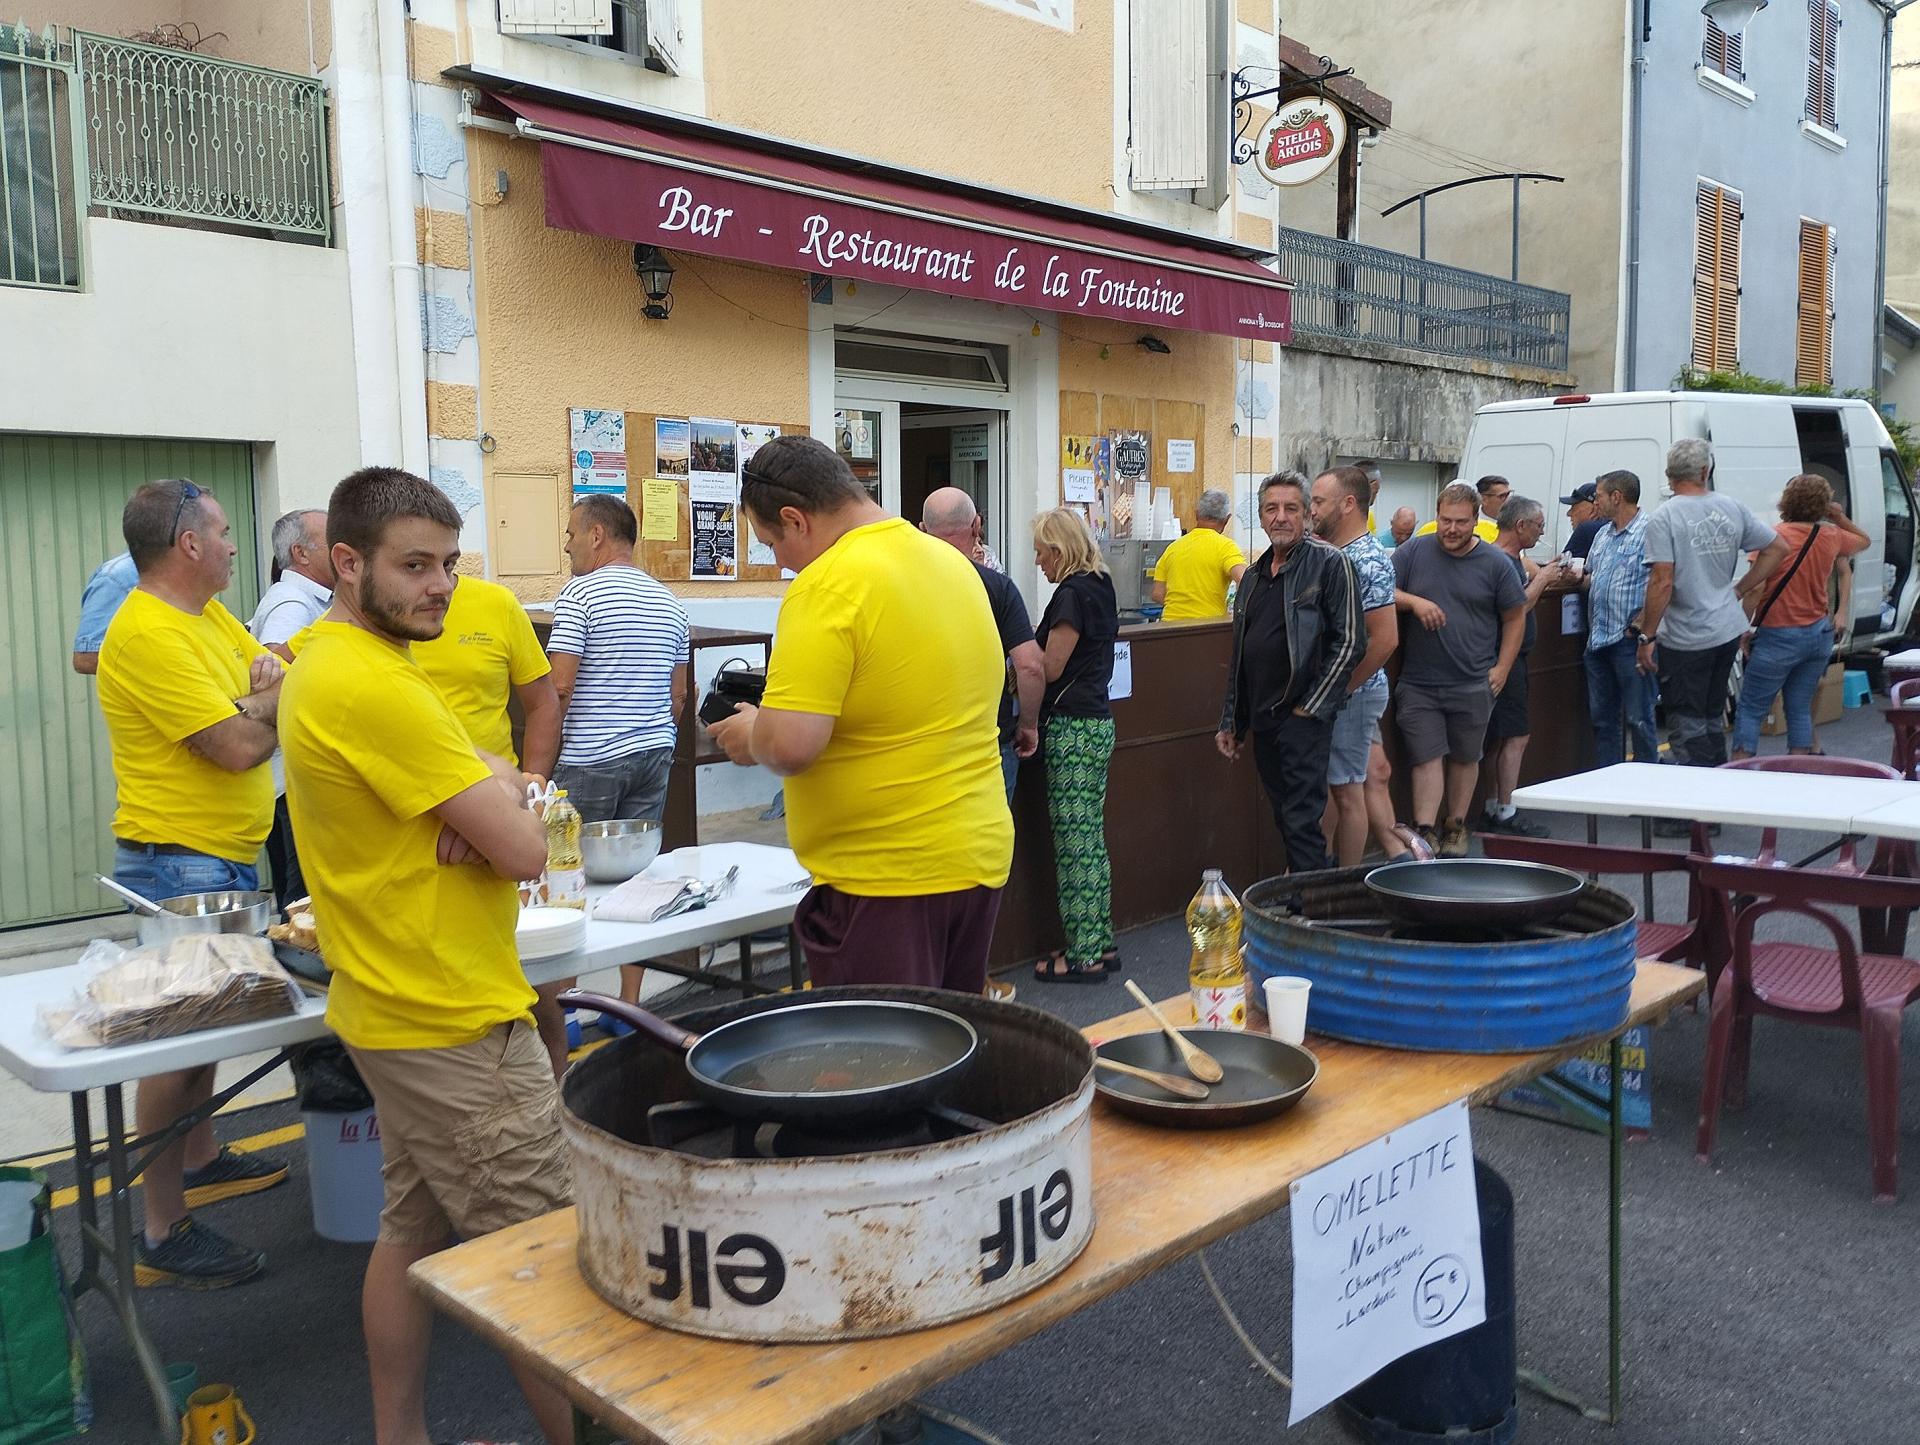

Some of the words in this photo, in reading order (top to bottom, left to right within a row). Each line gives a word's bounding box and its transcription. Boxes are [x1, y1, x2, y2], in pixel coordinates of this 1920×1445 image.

[1277, 138, 1322, 161] ARTOIS
[1278, 128, 1322, 148] STELLA
[658, 185, 734, 239] Bar
[798, 214, 975, 283] Restaurant
[994, 247, 1025, 291] de
[1042, 255, 1070, 298] la
[1077, 267, 1186, 316] Fontaine
[1116, 449, 1146, 463] GAUFRES
[696, 510, 717, 522] VOGUE
[1312, 1134, 1459, 1237] OMELETTE
[978, 1168, 1074, 1286] elf
[647, 1224, 787, 1310] elf
